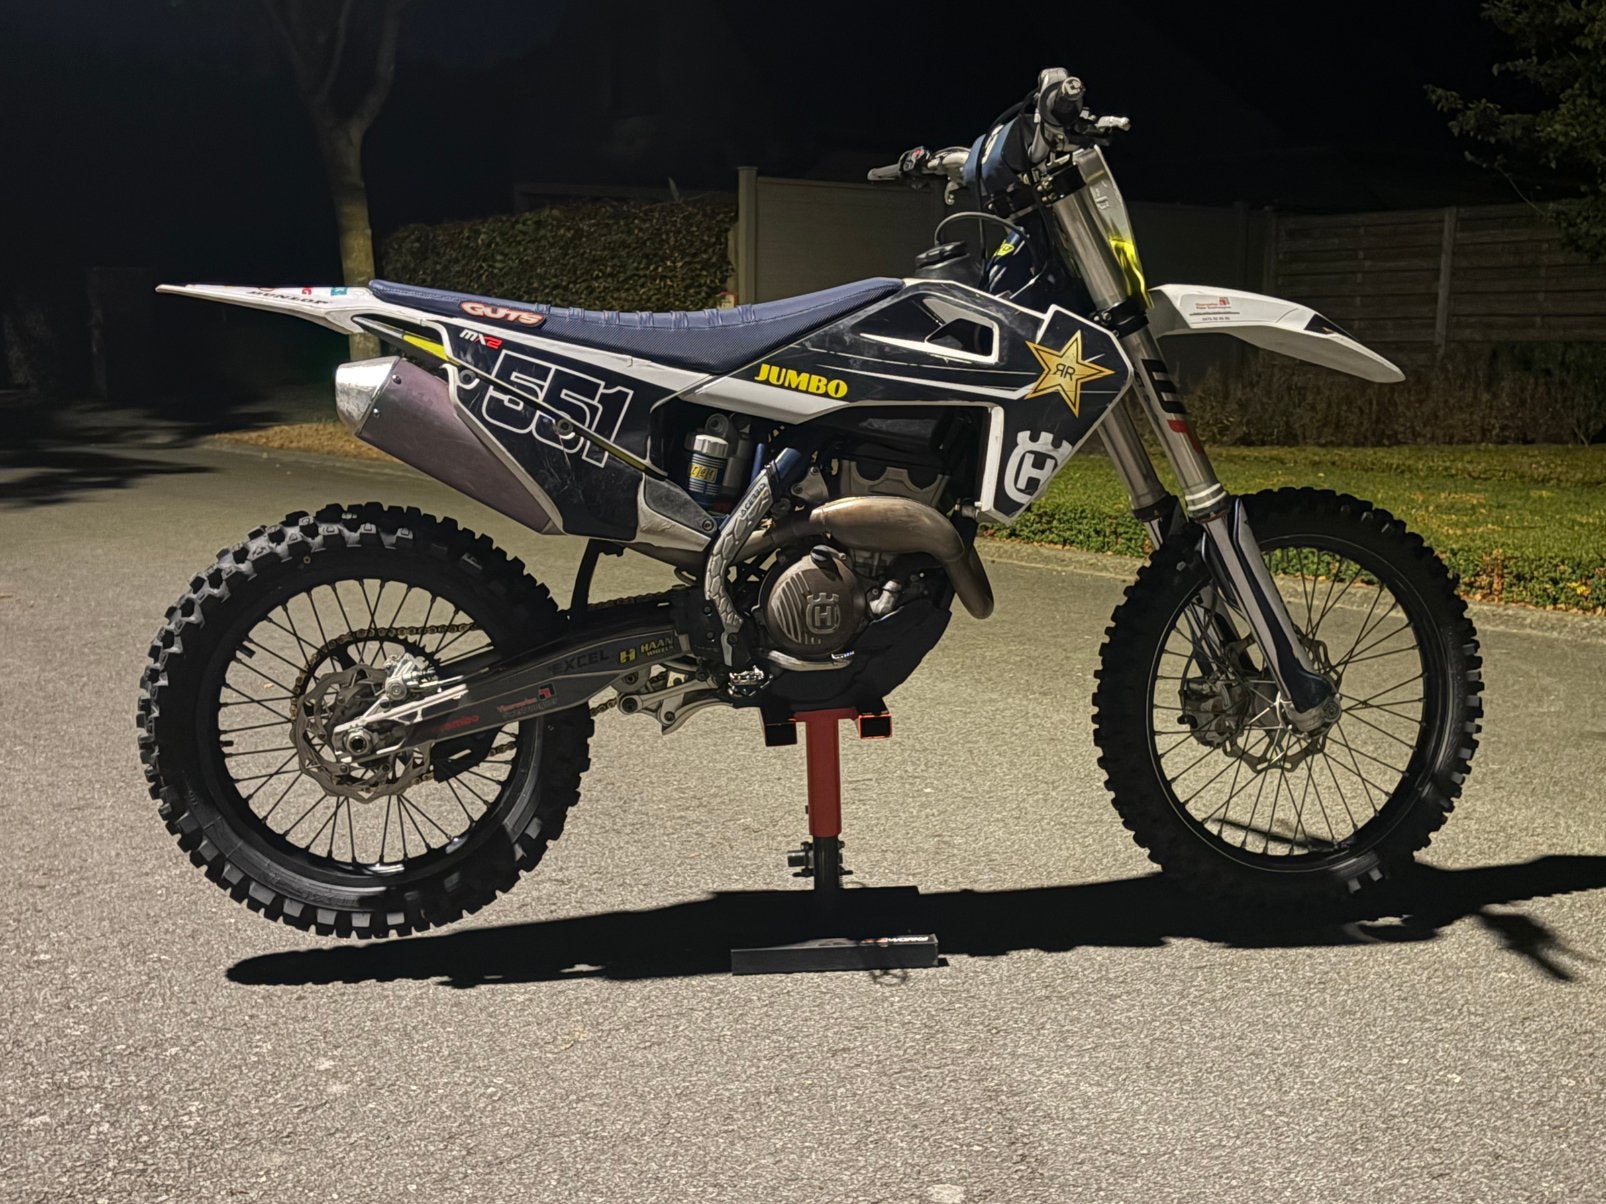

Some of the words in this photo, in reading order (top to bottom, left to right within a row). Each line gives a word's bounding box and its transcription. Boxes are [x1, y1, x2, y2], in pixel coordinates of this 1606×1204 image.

[461, 302, 545, 325] GUTS
[754, 363, 848, 398] JUMBO
[481, 349, 634, 468] 551
[640, 636, 673, 653] HAAN
[552, 649, 610, 674] EXCEL
